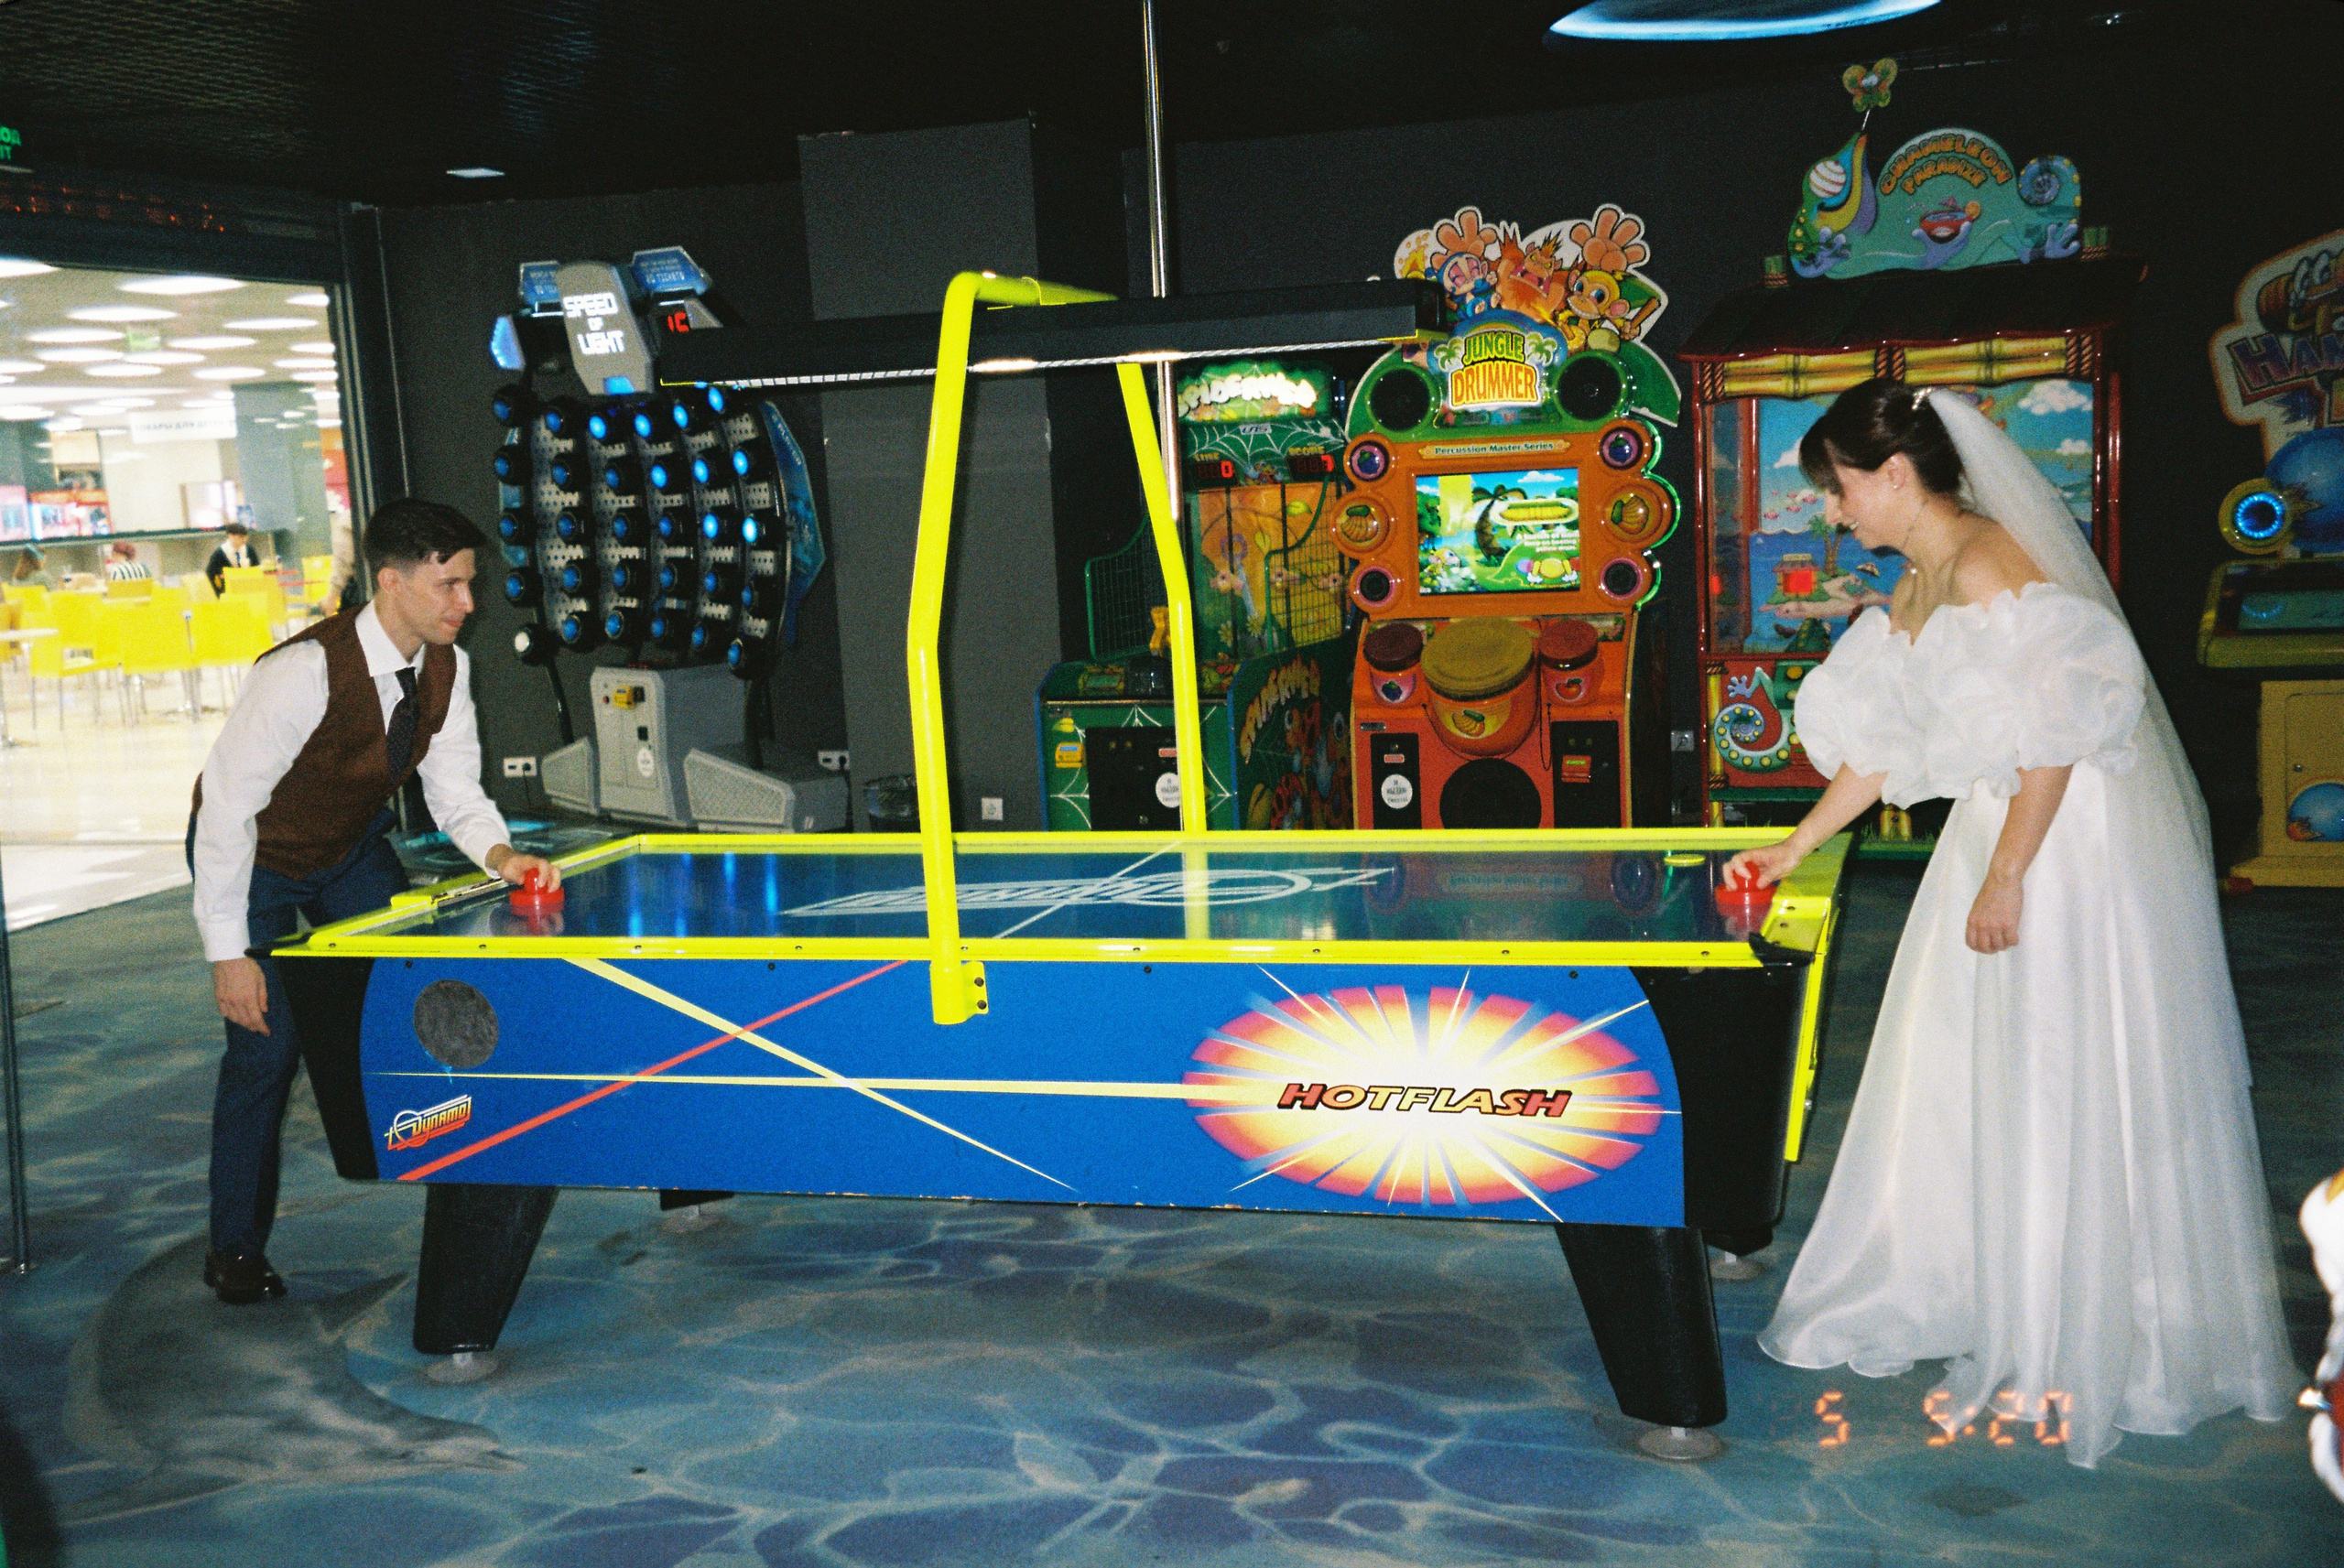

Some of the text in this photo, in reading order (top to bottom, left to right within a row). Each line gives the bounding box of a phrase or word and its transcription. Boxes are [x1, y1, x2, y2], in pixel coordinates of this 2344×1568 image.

[1880, 133, 2013, 195] CHAMELEON
[1901, 157, 1988, 195] PARADIZE
[562, 292, 619, 318] SPEED
[1462, 331, 1525, 364] JUNGLE
[1451, 361, 1538, 406] DRUMMER
[1434, 441, 1554, 455] Percussion Master Series
[1276, 1083, 1573, 1118] HOTFLASH
